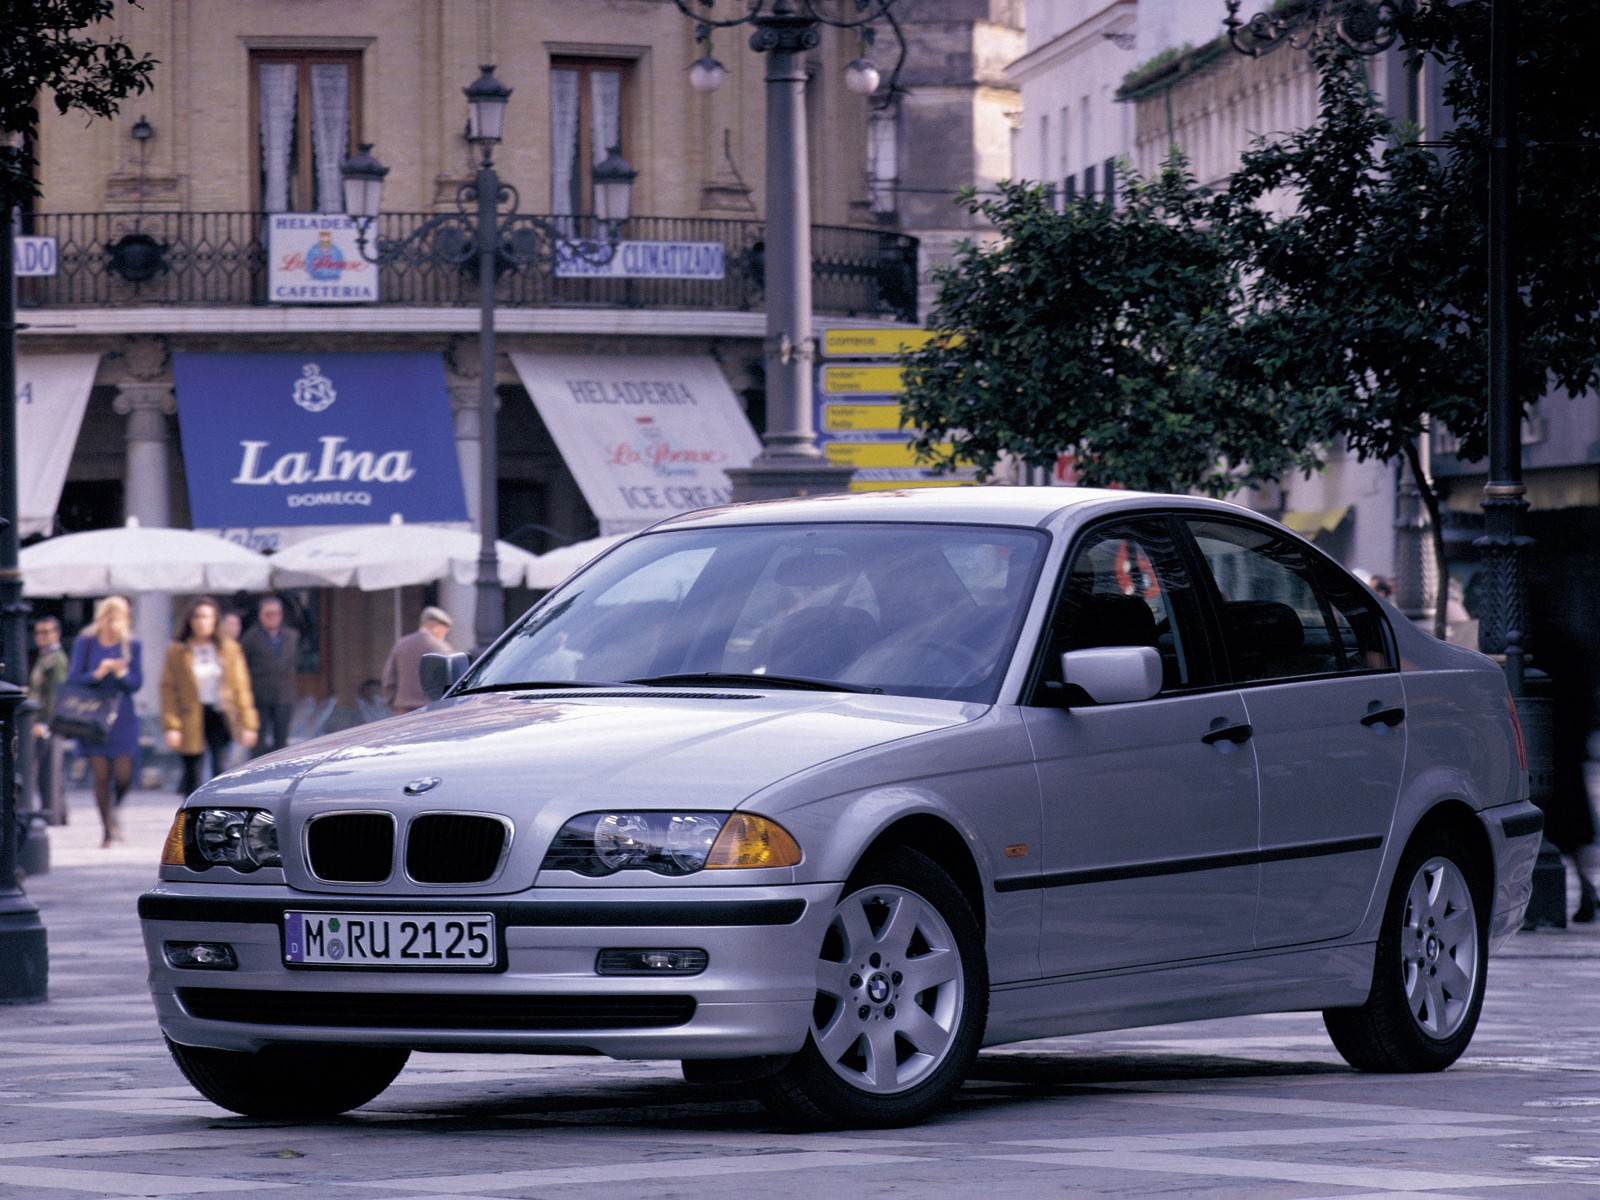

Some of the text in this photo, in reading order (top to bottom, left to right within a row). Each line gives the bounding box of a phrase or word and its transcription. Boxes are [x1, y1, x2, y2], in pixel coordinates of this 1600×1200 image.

[276, 218, 372, 230] HELADER
[276, 286, 372, 297] CAFETERIA
[565, 380, 698, 405] HELADERIA
[231, 436, 416, 485] La Ina
[286, 491, 372, 508] DOMECQ
[617, 486, 665, 509] ICE
[304, 919, 489, 960] M RU 2125
